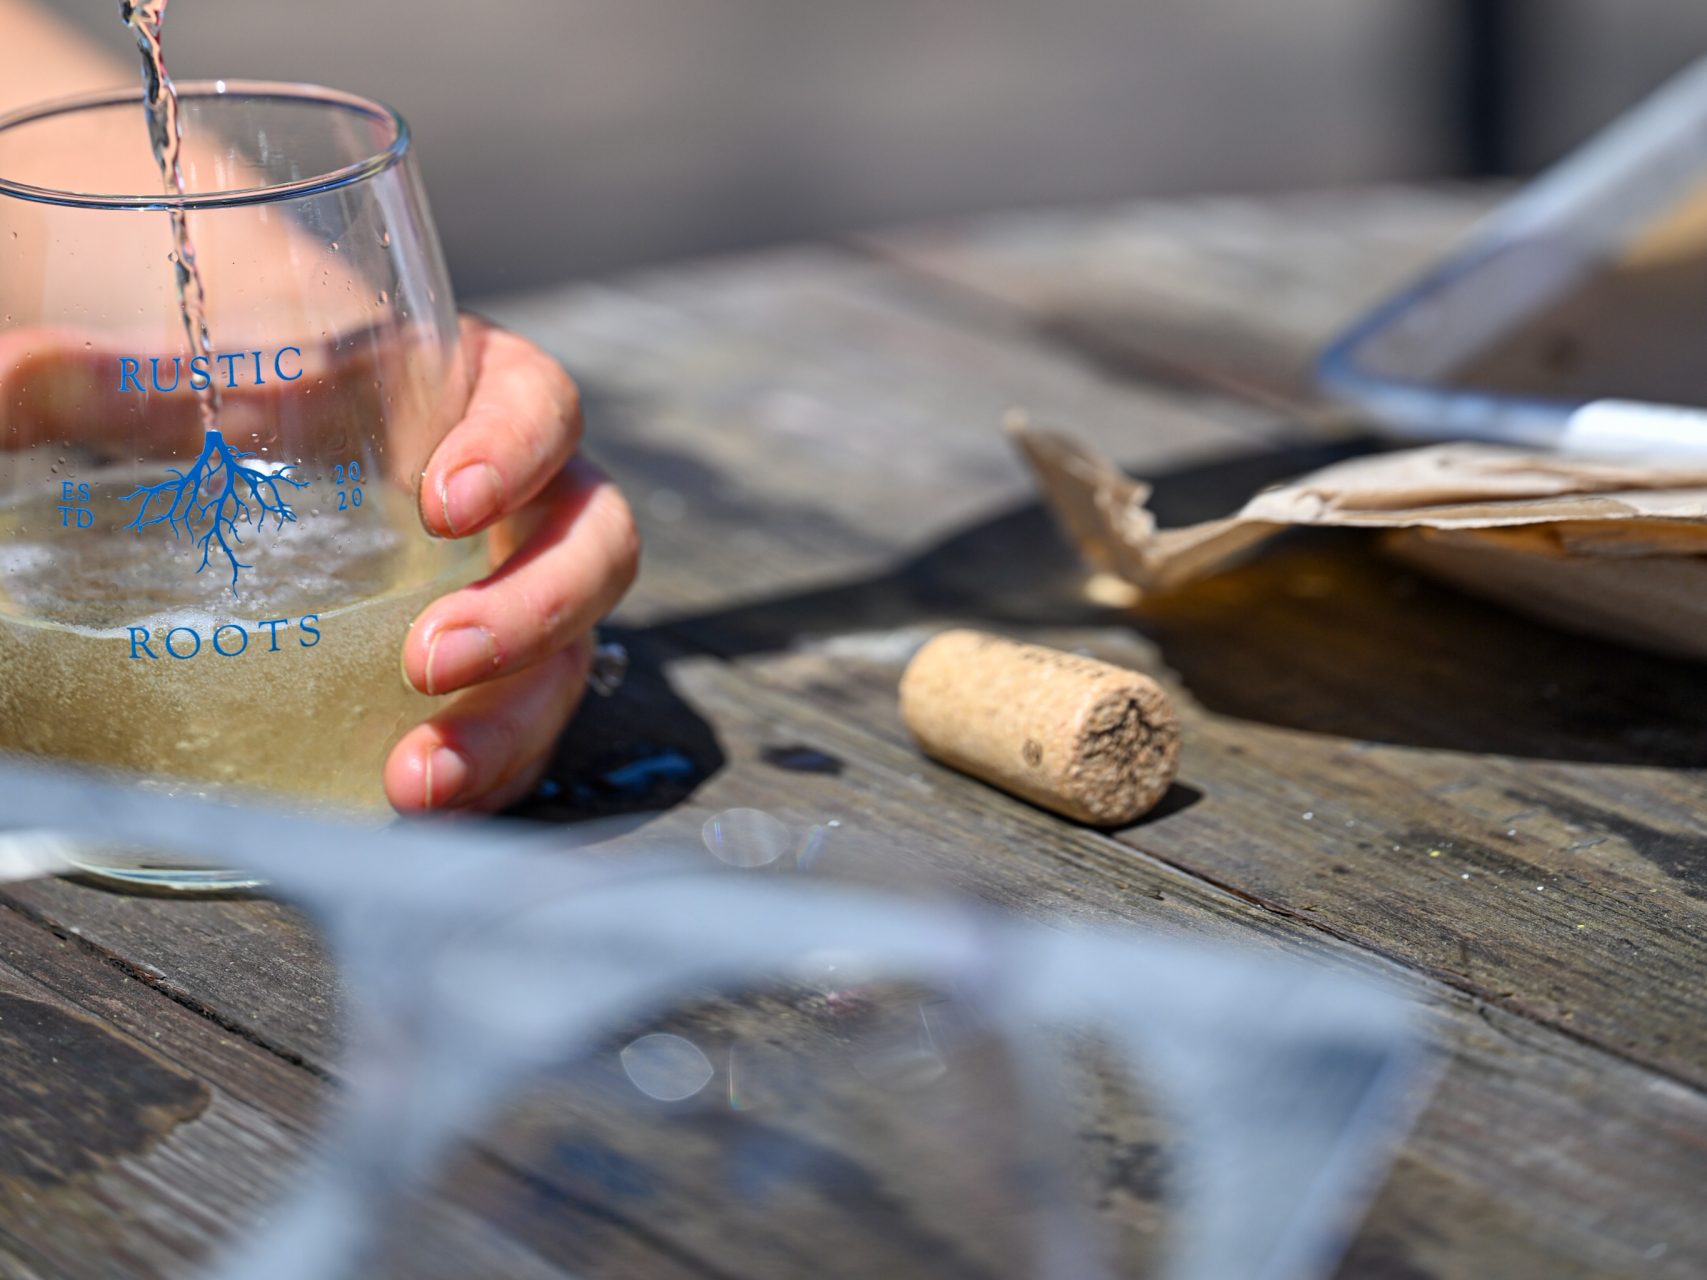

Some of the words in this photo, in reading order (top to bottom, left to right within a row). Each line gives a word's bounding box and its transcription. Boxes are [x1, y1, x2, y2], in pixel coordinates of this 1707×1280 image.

[117, 346, 304, 393] RUSTIC
[335, 460, 362, 485] 20
[61, 480, 91, 503] ES
[337, 487, 363, 512] 20
[57, 505, 95, 530] TD
[127, 614, 323, 661] ROOTS
